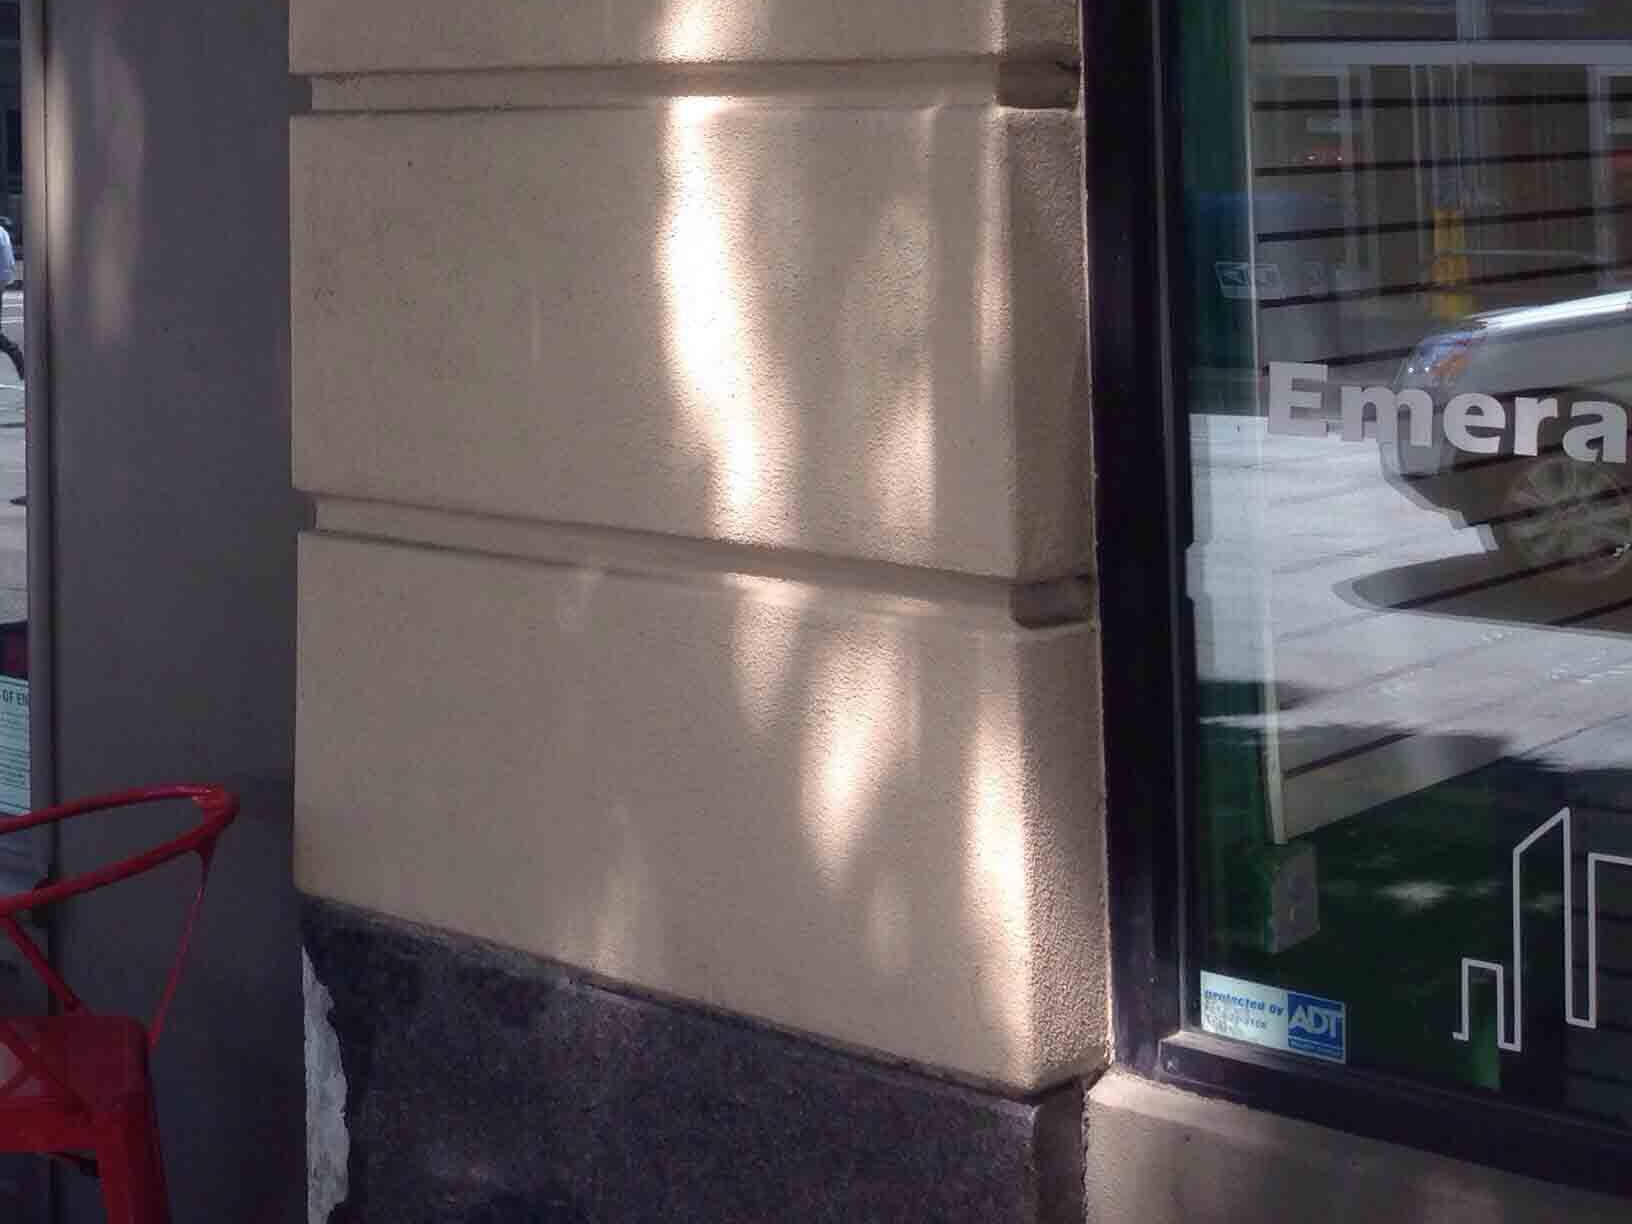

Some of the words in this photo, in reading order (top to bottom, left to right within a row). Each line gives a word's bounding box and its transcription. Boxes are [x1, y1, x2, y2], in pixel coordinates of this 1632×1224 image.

[1267, 361, 1627, 464] Emera
[2, 689, 16, 703] OF
[1288, 1004, 1346, 1039] ADT
